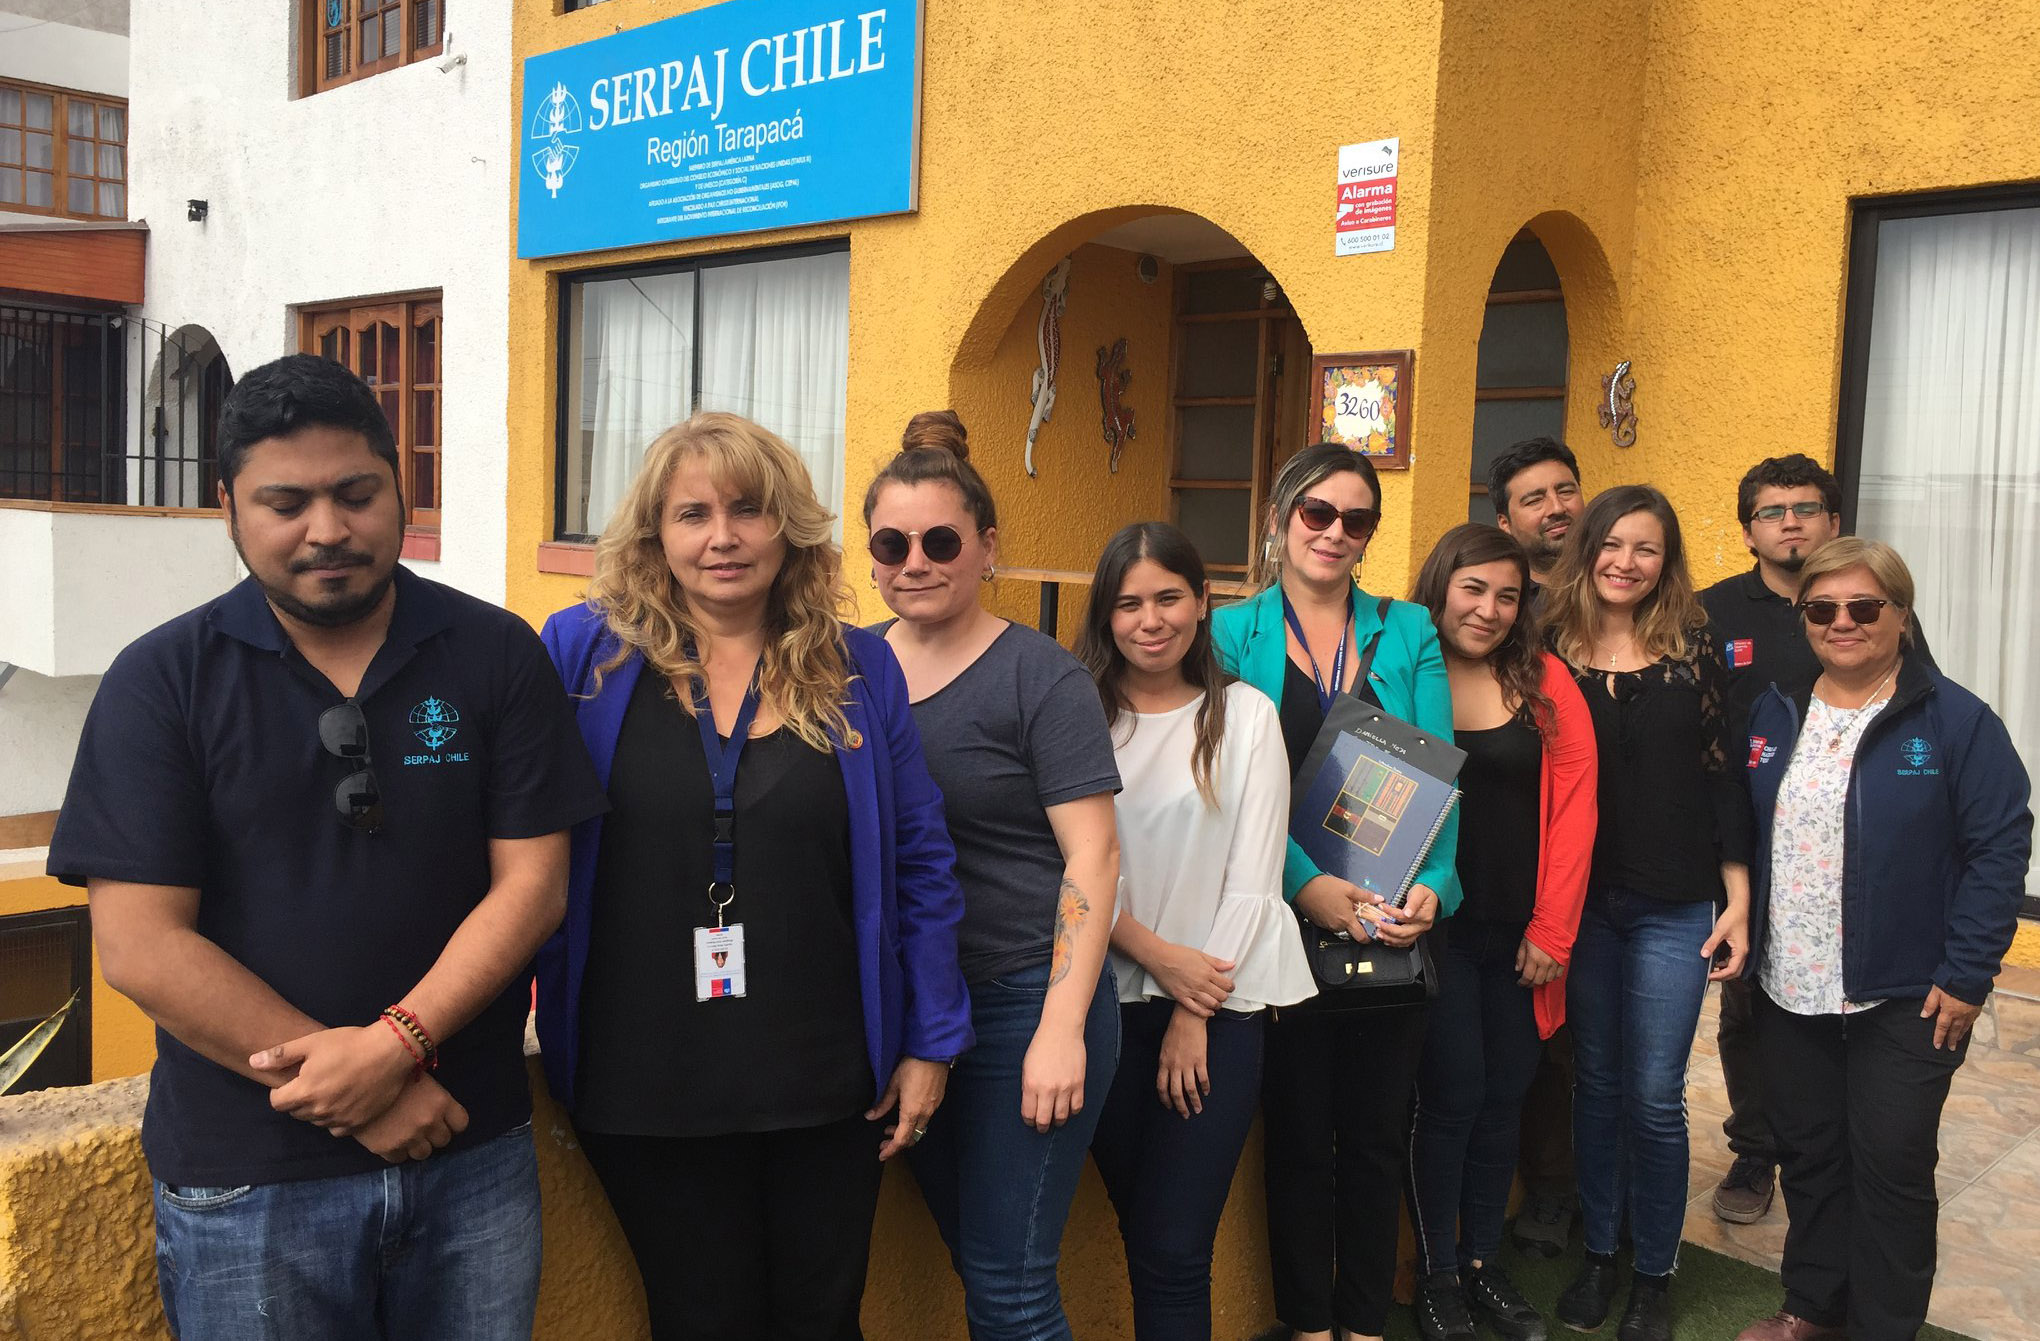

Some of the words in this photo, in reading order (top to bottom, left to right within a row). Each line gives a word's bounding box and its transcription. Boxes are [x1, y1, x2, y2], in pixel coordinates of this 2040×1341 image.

[589, 48, 729, 131] SERPAJ
[740, 9, 886, 97] CHILE
[647, 130, 709, 168] Región
[714, 108, 803, 153] Tarapacá
[1342, 163, 1394, 178] verisure
[1342, 184, 1392, 200] Alarma
[1338, 392, 1380, 421] 3260
[404, 754, 440, 766] SERPAJ
[446, 752, 469, 762] CHILE
